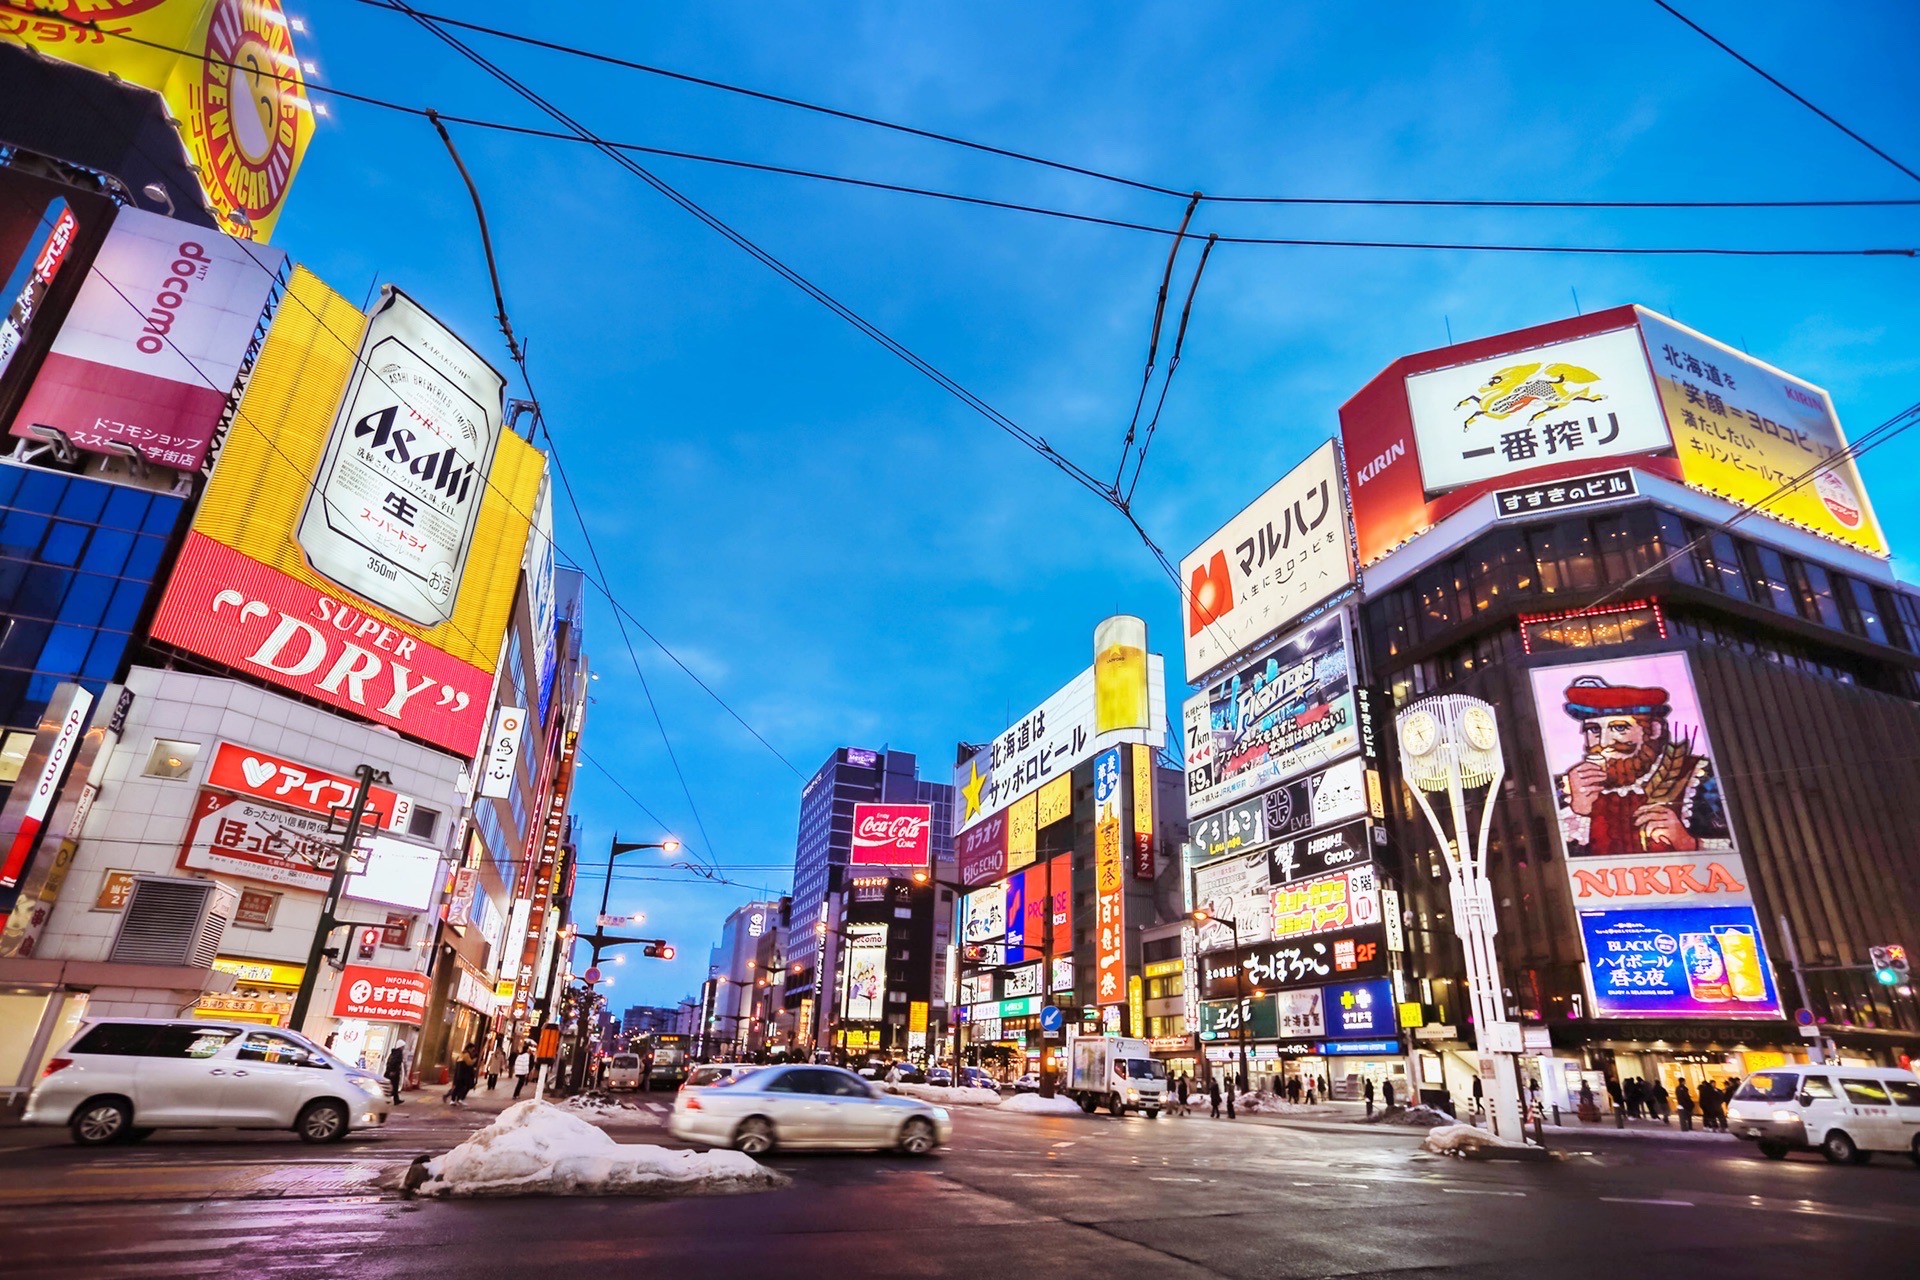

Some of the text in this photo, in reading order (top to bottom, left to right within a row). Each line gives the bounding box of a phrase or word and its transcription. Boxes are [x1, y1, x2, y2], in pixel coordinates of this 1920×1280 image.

[136, 241, 213, 354] docomo
[1662, 344, 1737, 391] 北海道を
[93, 417, 202, 450] ドコモショップ
[1461, 412, 1620, 462] 一番搾り
[354, 405, 475, 505] Asahi
[1356, 438, 1406, 487] KIRIN
[382, 491, 418, 528] 生
[1502, 477, 1627, 511] すすきのビル
[360, 507, 428, 553] スーパードライ
[1235, 479, 1330, 577] マルハン
[366, 556, 397, 582] 350ml
[311, 597, 418, 661] SUPER
[40, 709, 80, 796] docomo
[990, 710, 1046, 772] 北海道は
[989, 724, 1087, 807] サッポロビール
[275, 764, 376, 817] アイフル
[859, 815, 923, 839] Coca-Cola
[966, 818, 1003, 853] カラオケ
[1195, 808, 1252, 850] くろねこ
[1290, 812, 1311, 832] EVE
[1140, 834, 1150, 870] カラオケ
[1209, 835, 1242, 855] Lounge
[1324, 848, 1355, 866] Group
[1275, 880, 1349, 915] ネットカフェ
[1573, 862, 1746, 898] NIKKA
[1027, 890, 1067, 918] PROISE
[852, 933, 882, 944] ocomo
[1356, 942, 1377, 963] 2F
[1606, 940, 1656, 952] BLACK
[1595, 954, 1674, 969] ハイボール
[1609, 968, 1669, 987] 香る夜
[1621, 1026, 1711, 1040] SUSUKINO
